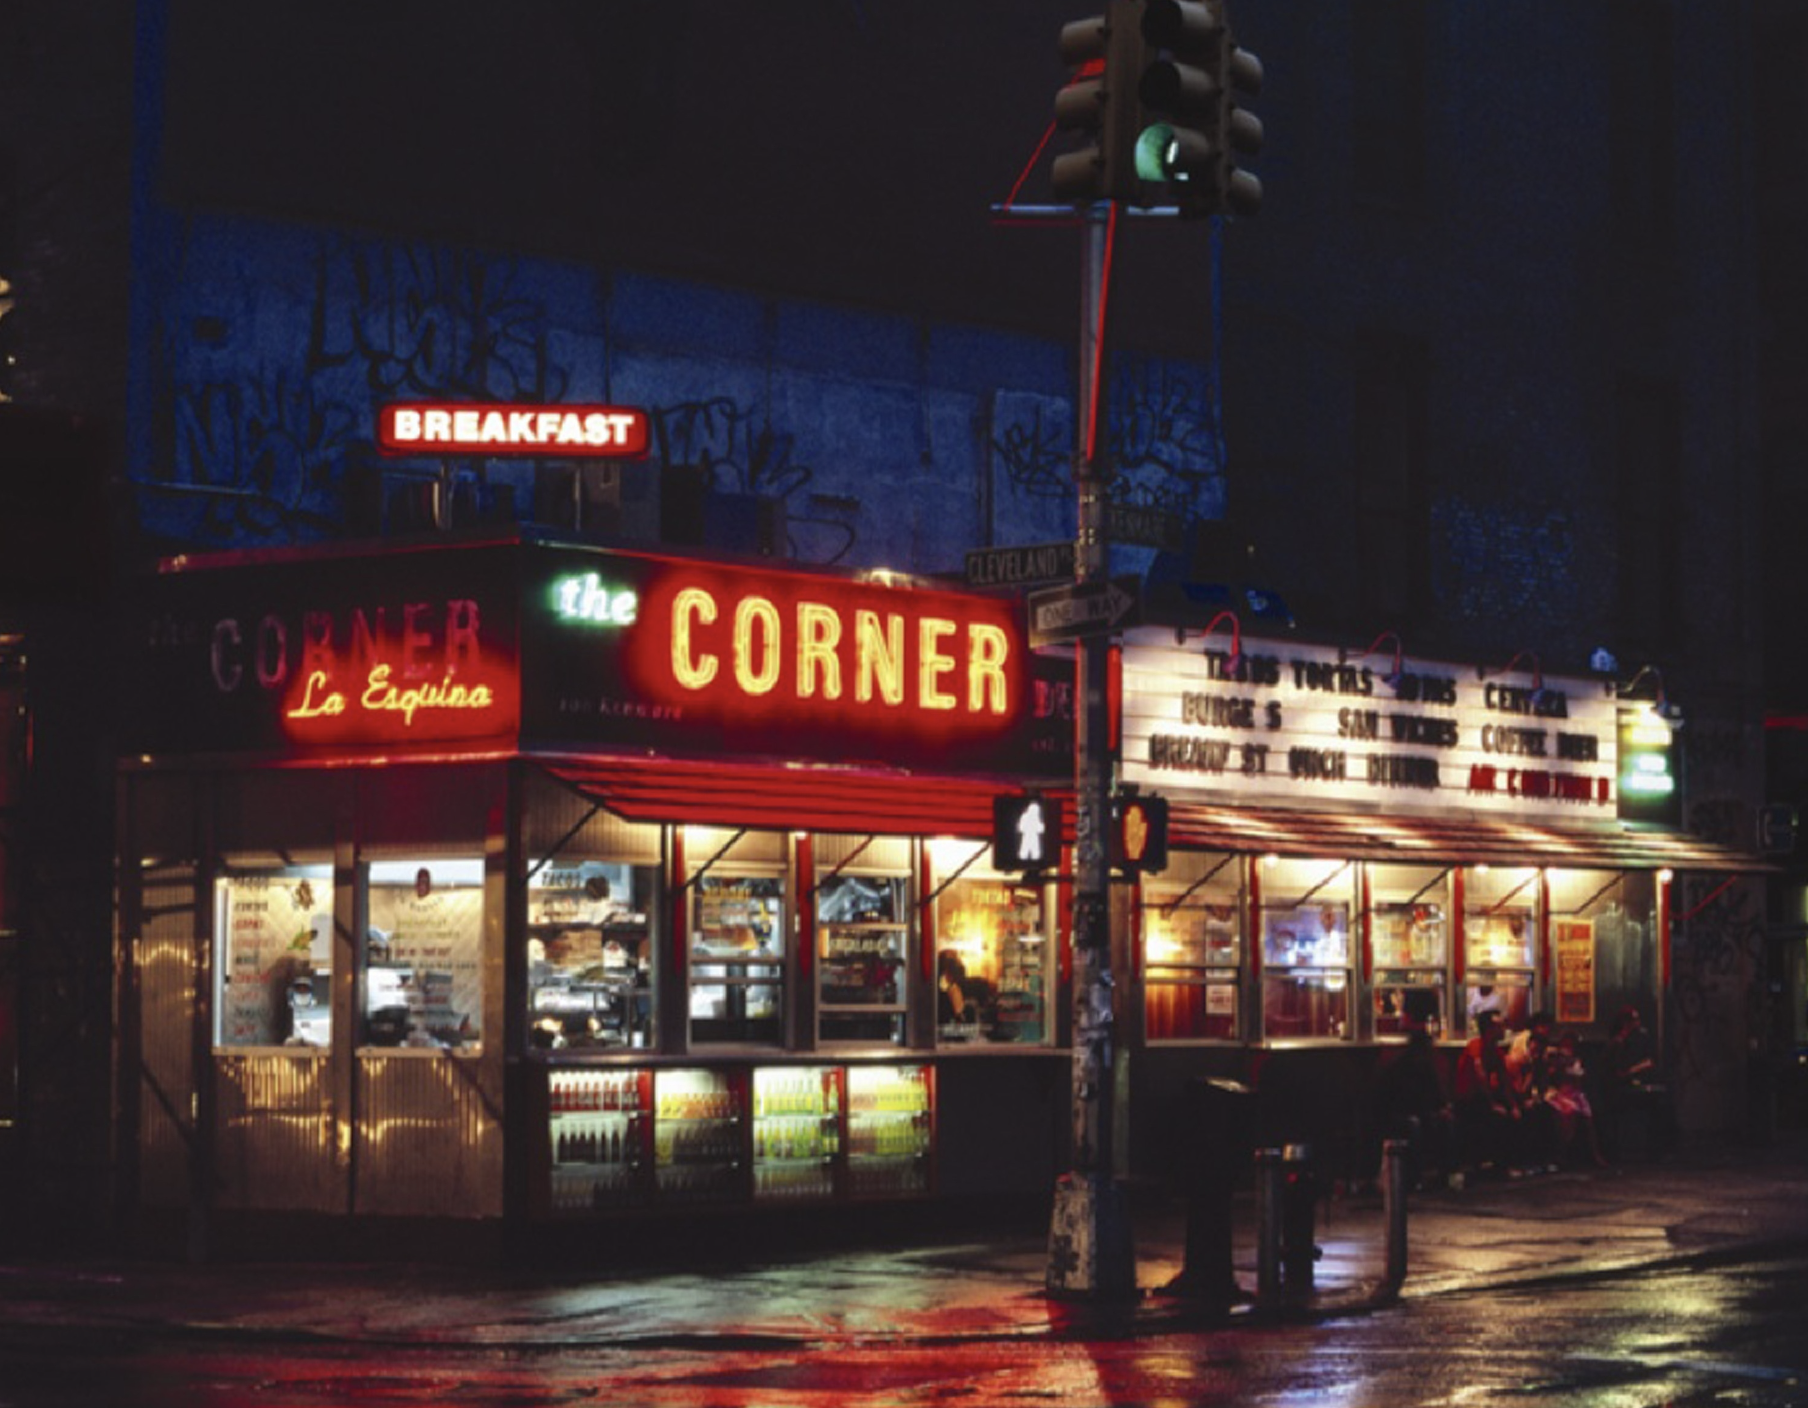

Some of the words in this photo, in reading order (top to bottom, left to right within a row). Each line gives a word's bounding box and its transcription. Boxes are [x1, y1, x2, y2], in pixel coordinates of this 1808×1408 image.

[394, 409, 634, 445] BREAKFAST
[968, 547, 1058, 584] CLEVELAND
[552, 572, 638, 626] the
[671, 587, 1008, 714] CORNER
[288, 671, 346, 718] La
[361, 663, 493, 726] Esquina
